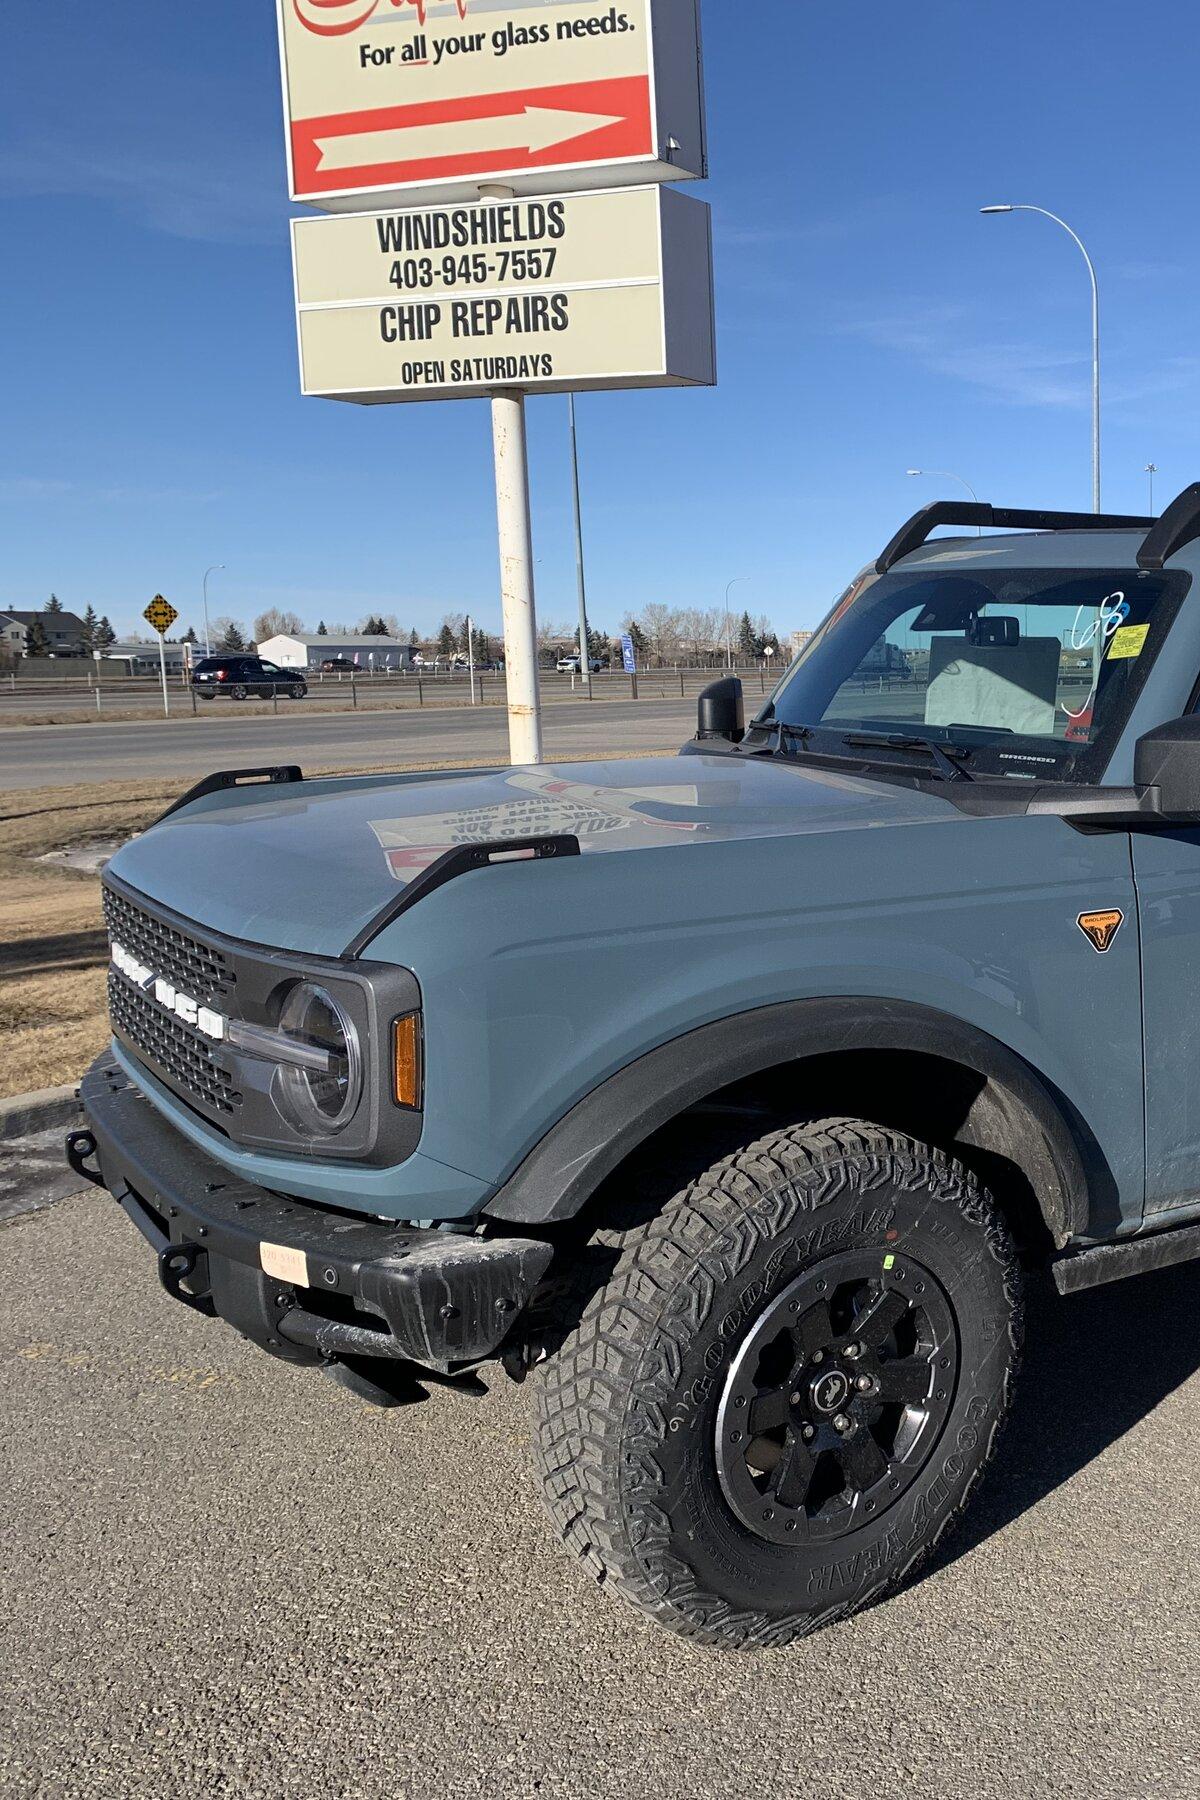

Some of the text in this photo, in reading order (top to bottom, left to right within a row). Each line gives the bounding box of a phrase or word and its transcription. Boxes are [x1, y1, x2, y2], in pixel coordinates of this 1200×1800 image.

[360, 8, 634, 67] For all your glass needs.
[376, 201, 565, 253] WINDSHIELDS
[389, 248, 557, 290] 403-945-7557
[381, 294, 568, 342] CHIP REPAIRS
[402, 354, 552, 384] OPEN SATURDAYS
